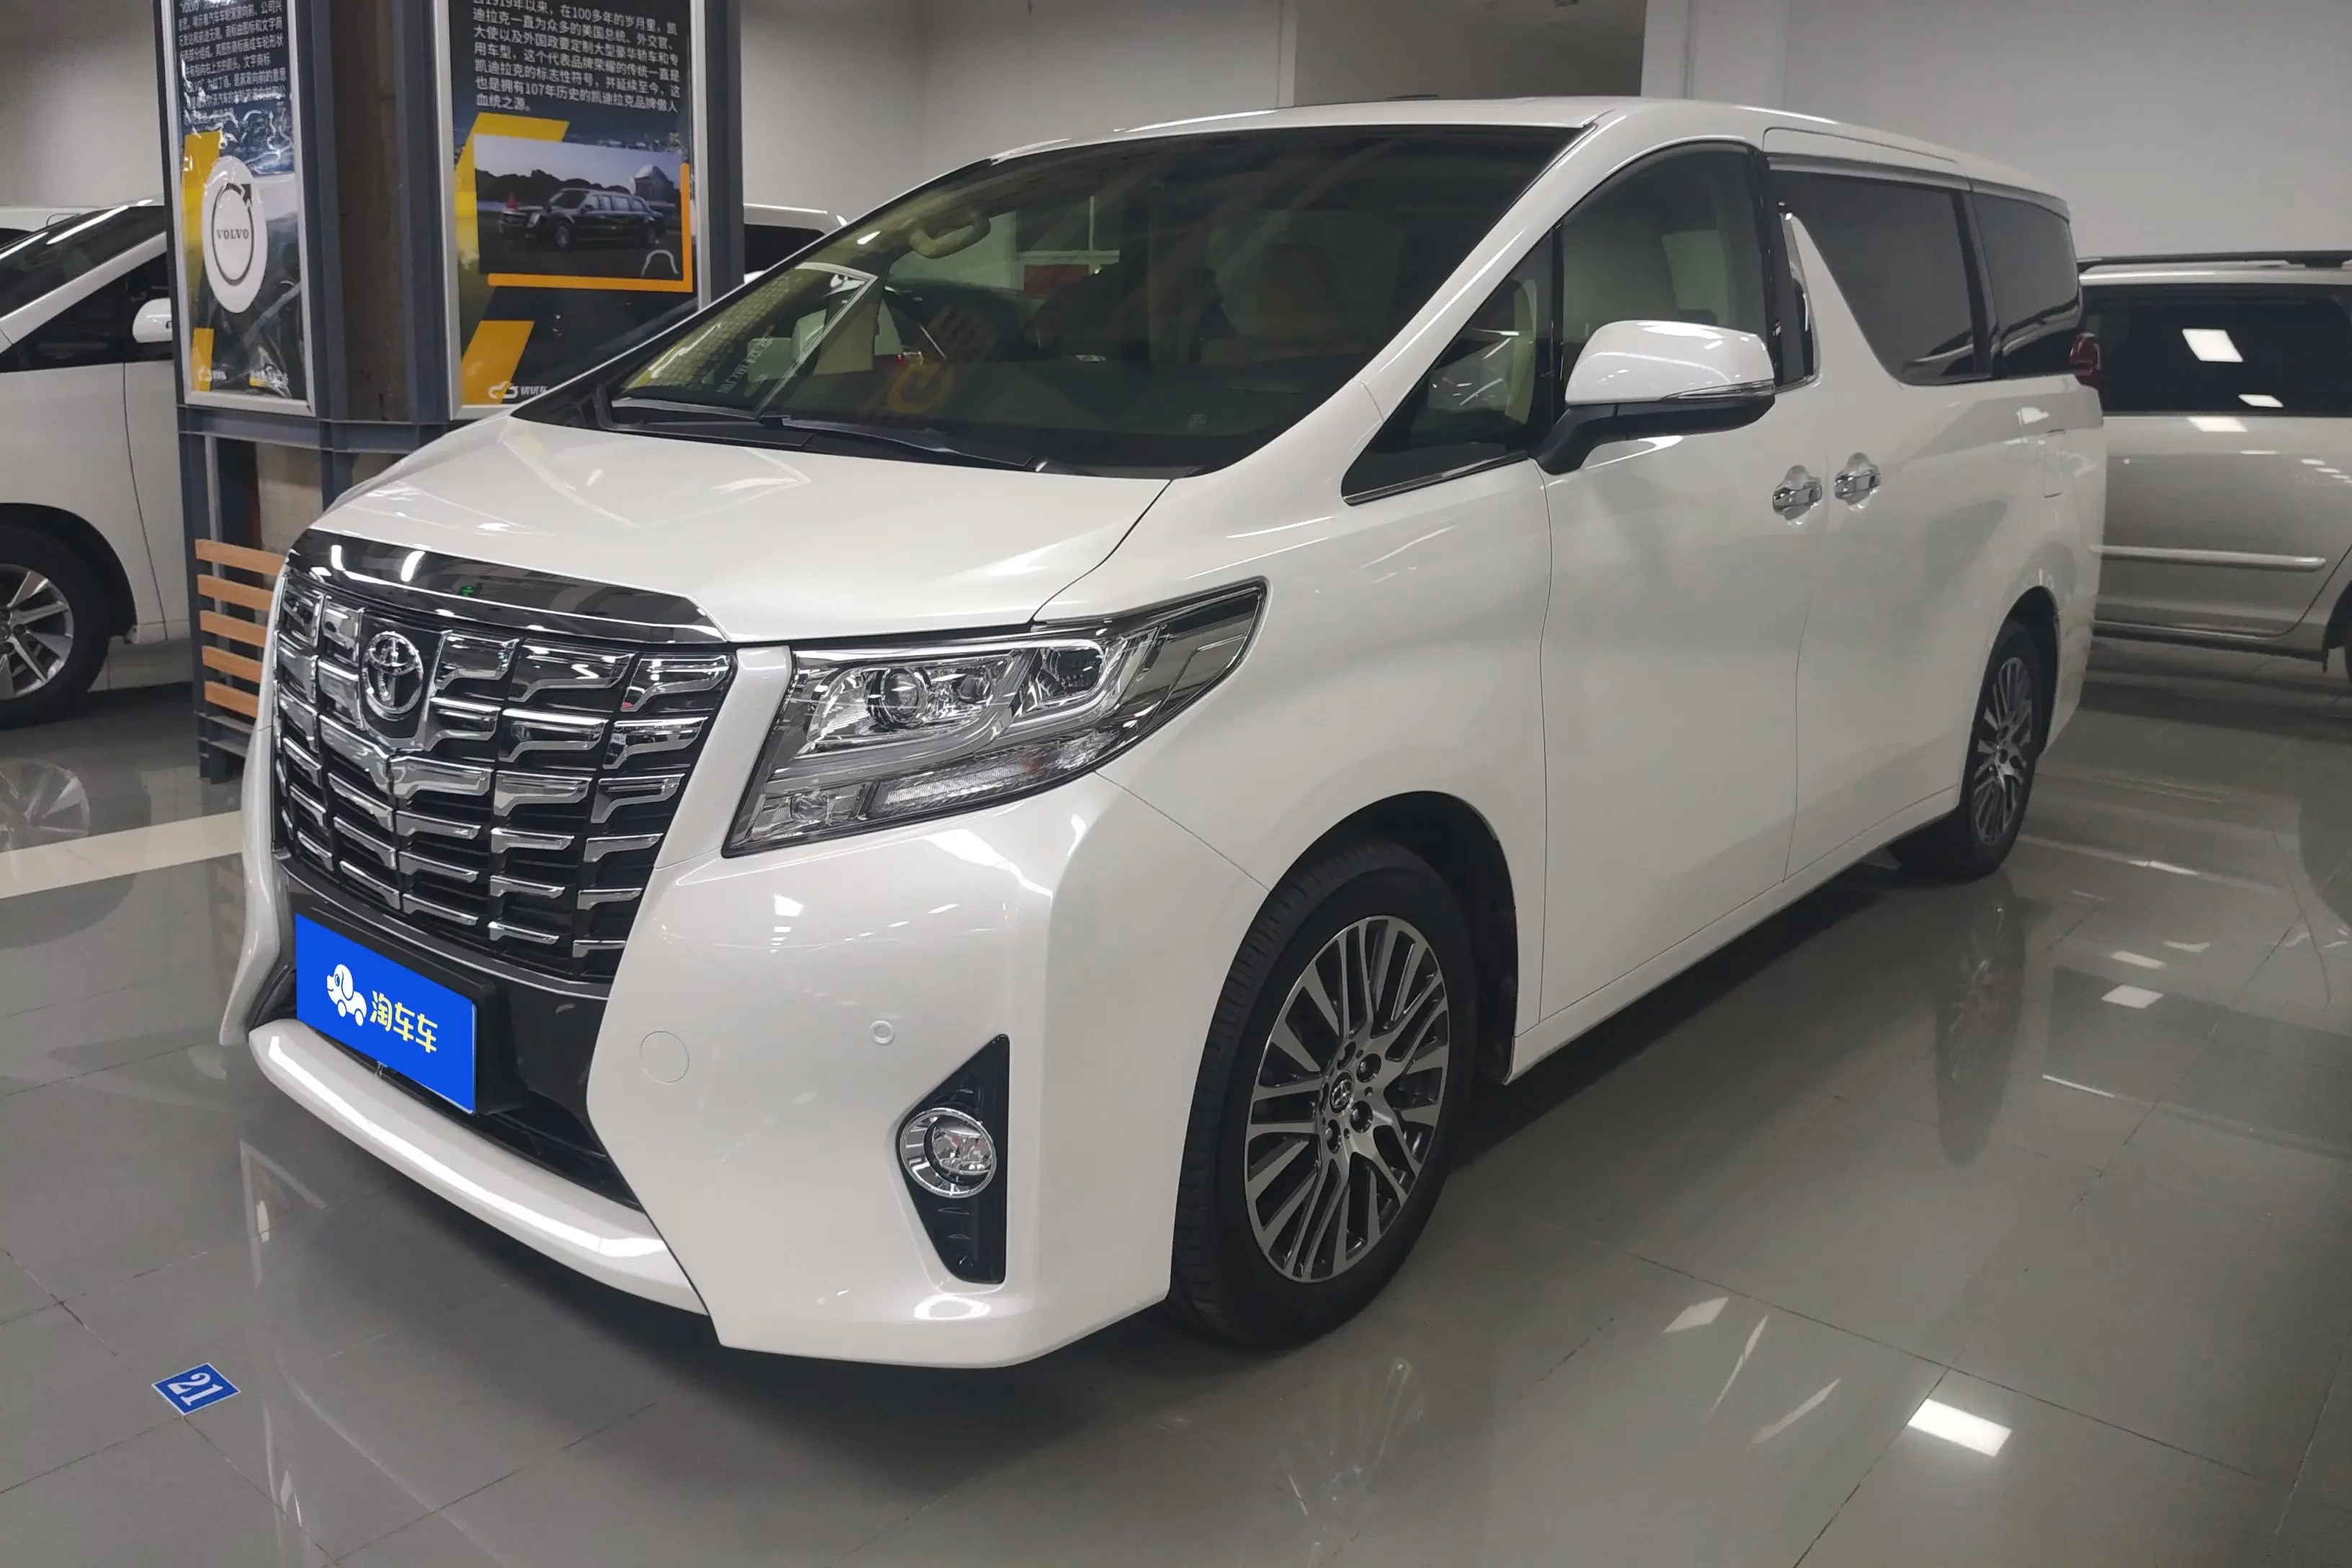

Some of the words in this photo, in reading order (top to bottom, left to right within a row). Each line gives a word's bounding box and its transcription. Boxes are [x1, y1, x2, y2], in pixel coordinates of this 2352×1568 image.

[476, 93, 530, 112] 血统之源。
[216, 228, 249, 240] VOLVO
[166, 1373, 223, 1406] 21
